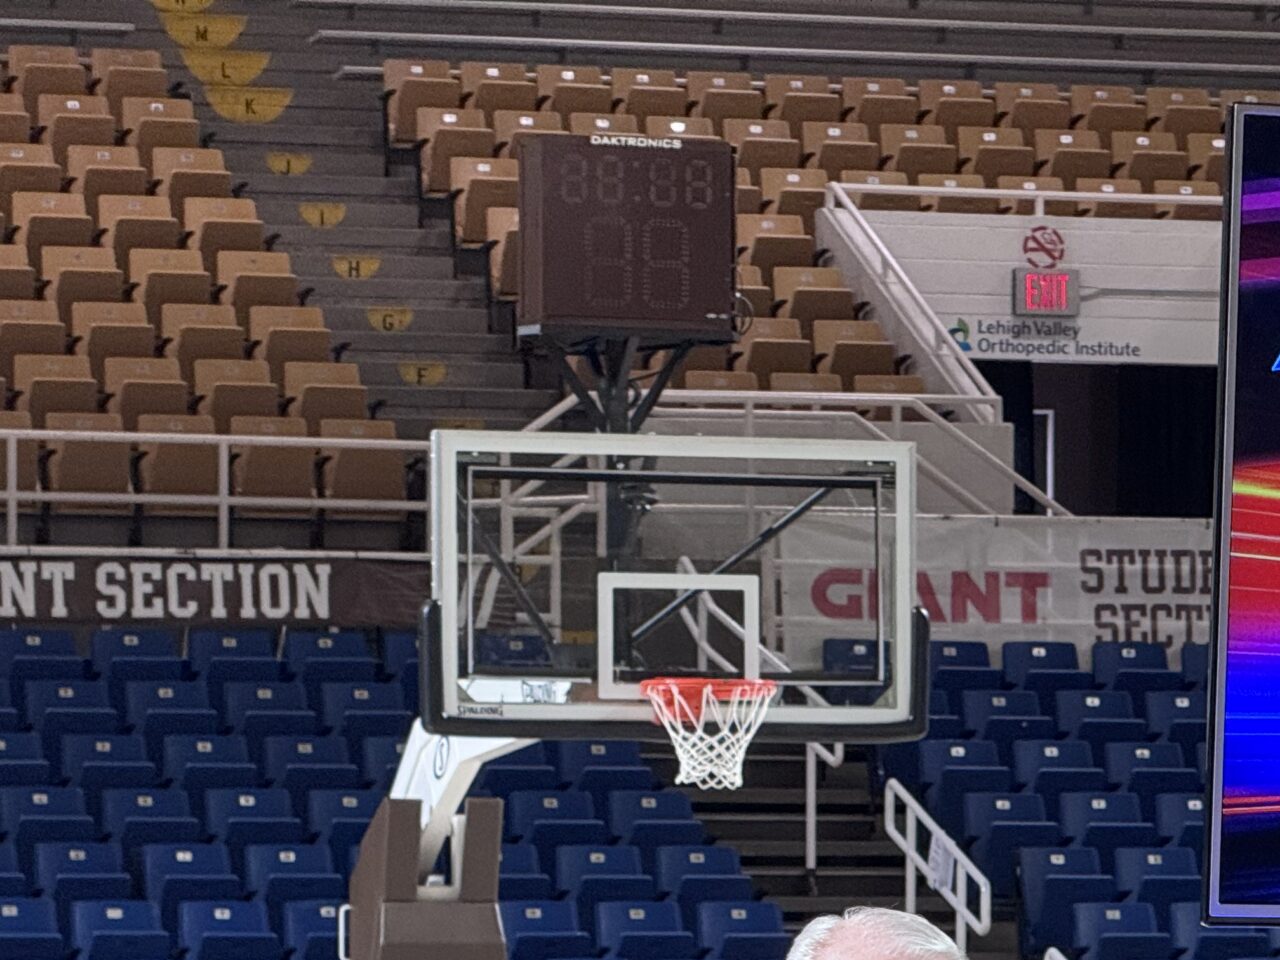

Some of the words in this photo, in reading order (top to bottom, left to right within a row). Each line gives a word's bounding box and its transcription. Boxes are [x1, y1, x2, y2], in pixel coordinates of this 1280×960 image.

[220, 61, 232, 79] L
[244, 98, 257, 115] K
[590, 135, 683, 149] DAKTRONICS
[282, 159, 292, 175] J
[348, 260, 361, 278] H
[1025, 272, 1069, 312] EXIT
[382, 313, 395, 331] G
[977, 318, 1031, 338] Lehigh
[1033, 321, 1082, 340] Valley
[977, 337, 1070, 357] Orthopedic
[1075, 341, 1141, 358] Institute
[95, 561, 332, 620] SECTION
[1094, 603, 1212, 648] SECT
